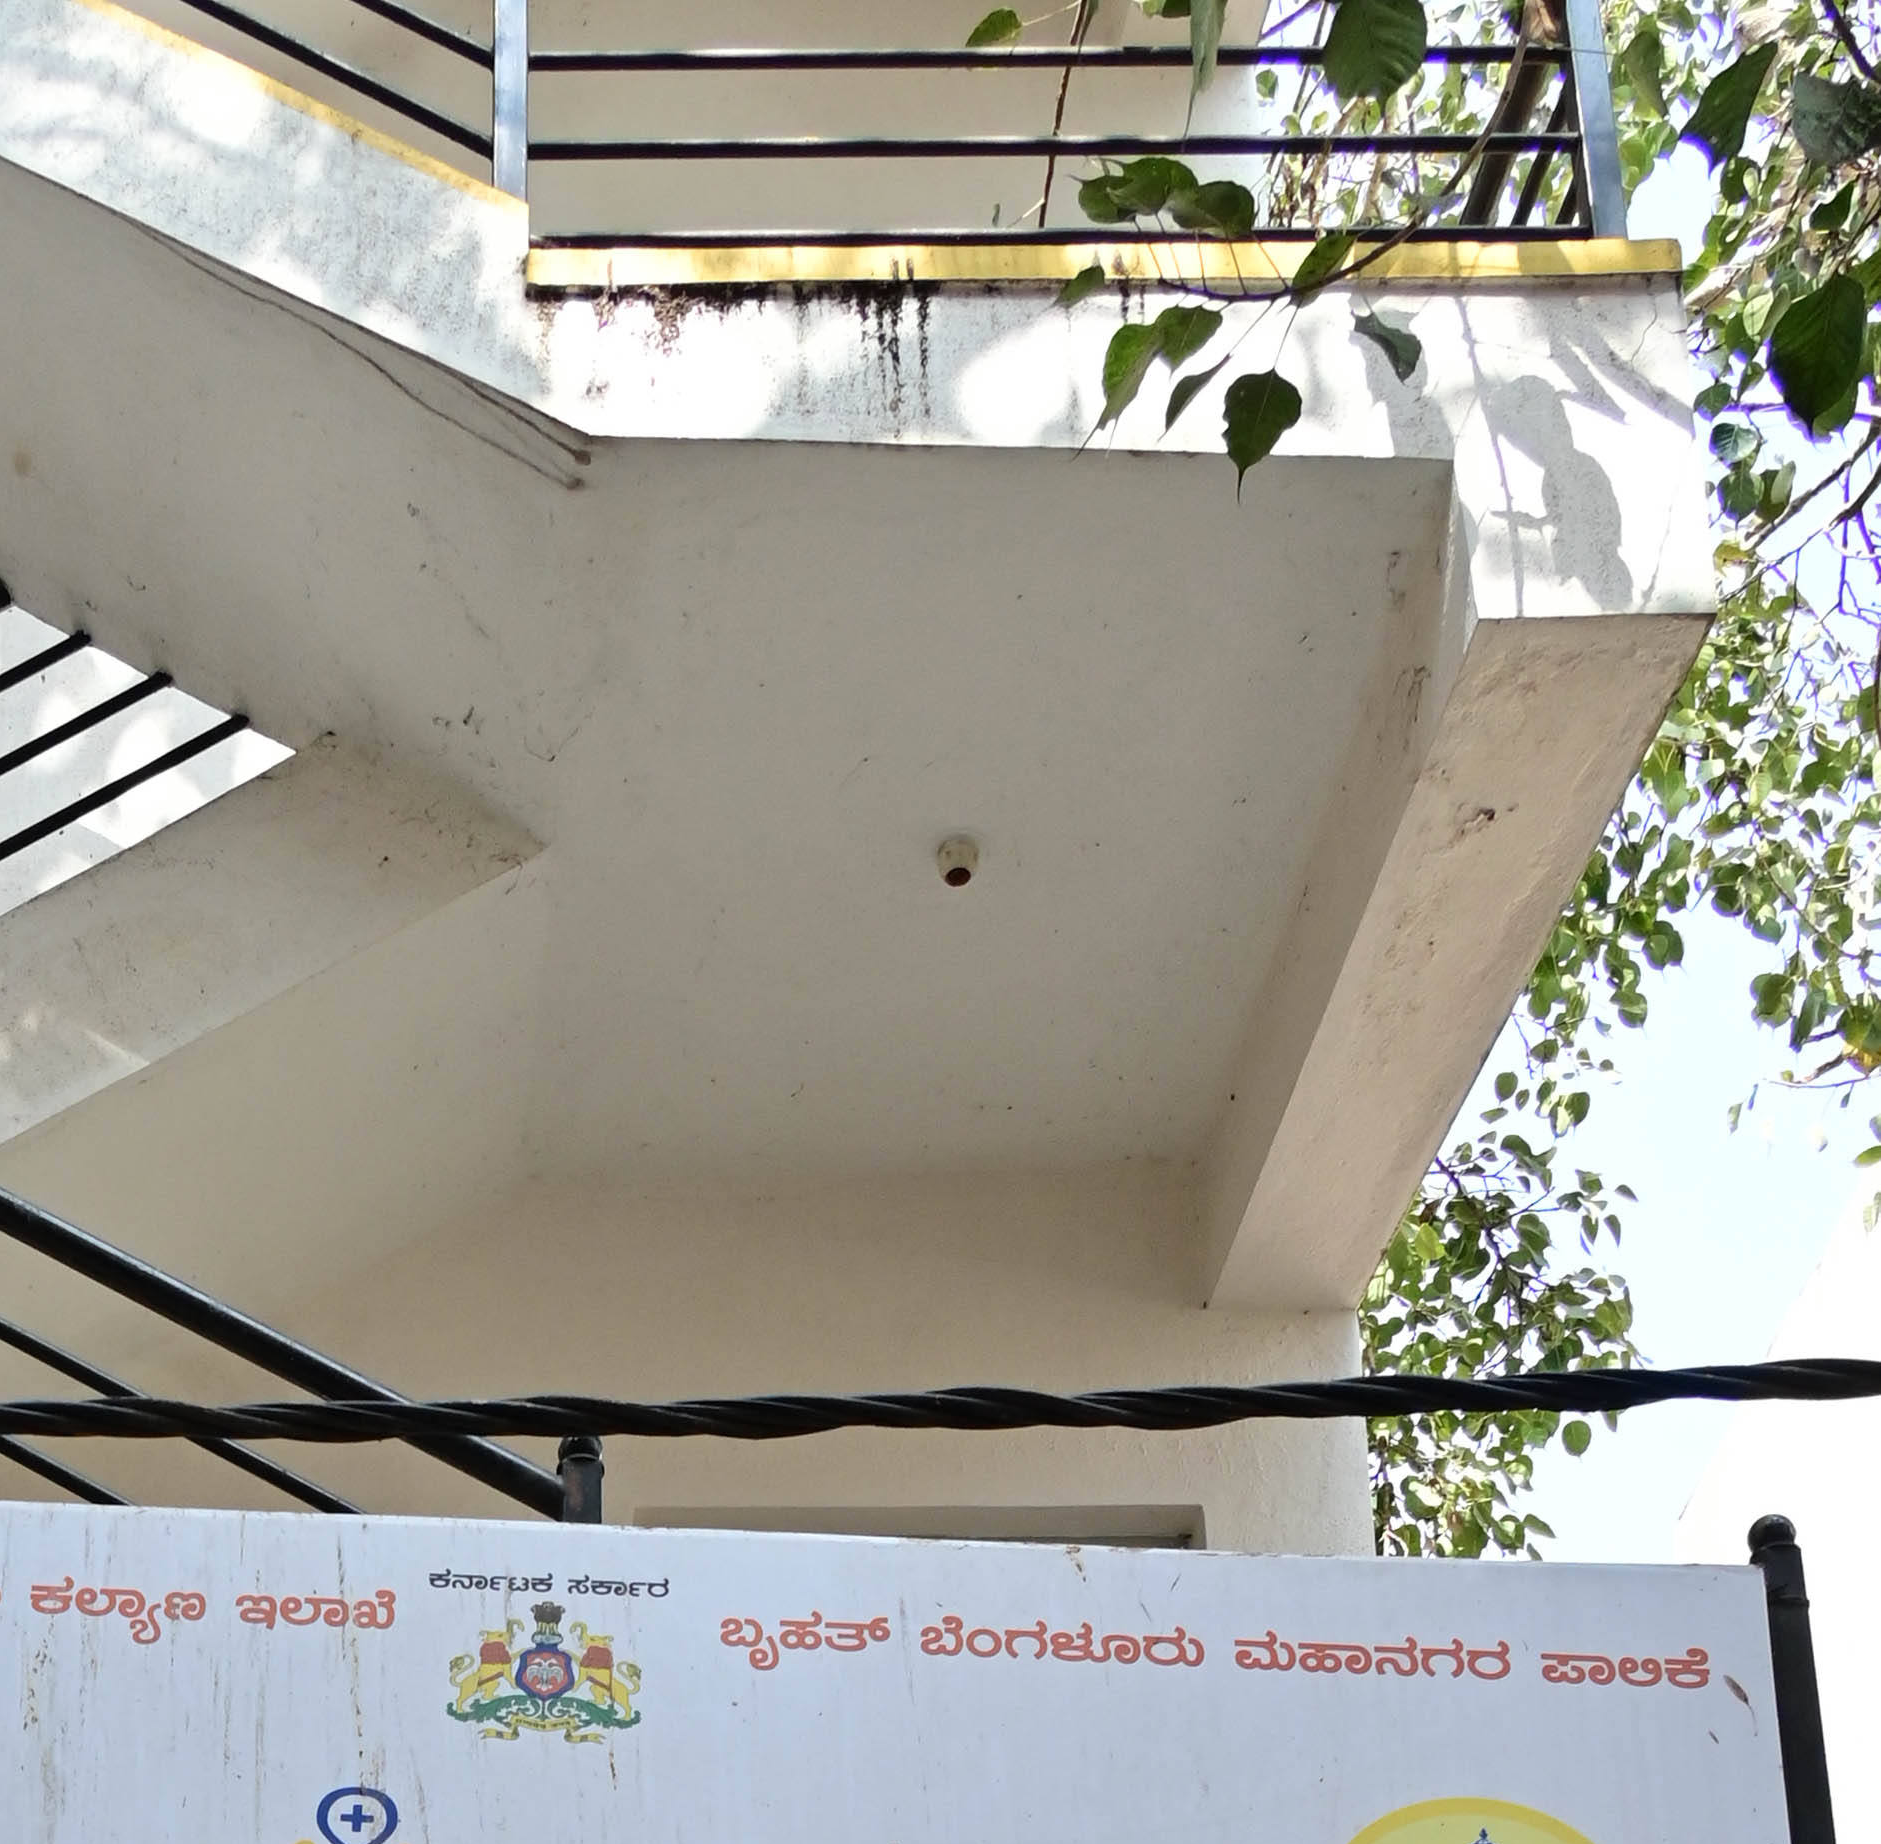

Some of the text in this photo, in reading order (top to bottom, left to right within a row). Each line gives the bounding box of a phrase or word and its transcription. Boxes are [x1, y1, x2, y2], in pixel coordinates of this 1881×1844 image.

[30, 1582, 207, 1645] ಕಲ್ಯಾಣ
[235, 1588, 397, 1632] ಇಲಾಖೆ
[429, 1568, 670, 1598] ಕರ್ನಾಟಕ ಸರ್ಕಾರ
[718, 1610, 1713, 1690] ಬೃಹತ್ ಬೆಂಗಳೂರು ಮಹಾನಗರ ಪಾಲಿಕೆ
